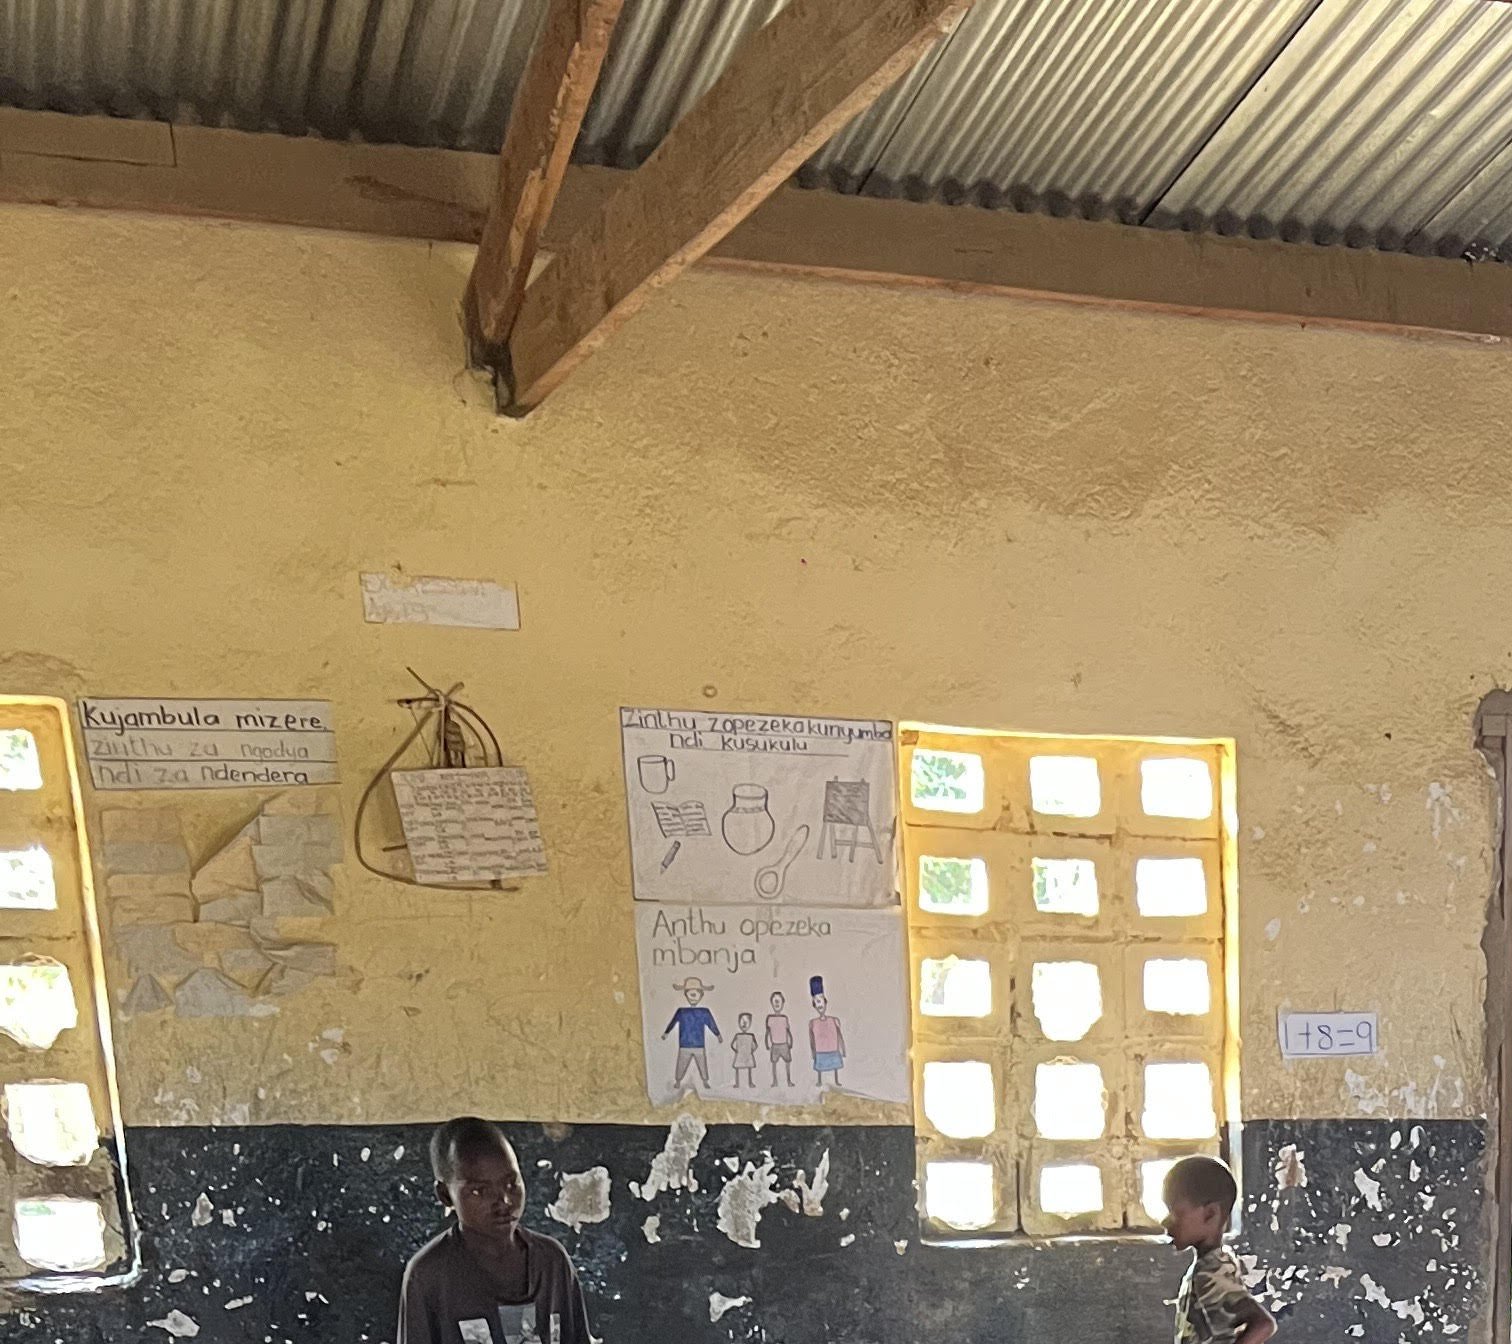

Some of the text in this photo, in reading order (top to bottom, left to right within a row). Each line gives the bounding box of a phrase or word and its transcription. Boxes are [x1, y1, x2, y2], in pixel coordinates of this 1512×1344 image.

[82, 700, 220, 736] Kujambula
[721, 735, 807, 751] kusukulu
[201, 763, 308, 784] ndendera
[652, 908, 832, 943] Anthu opezeka
